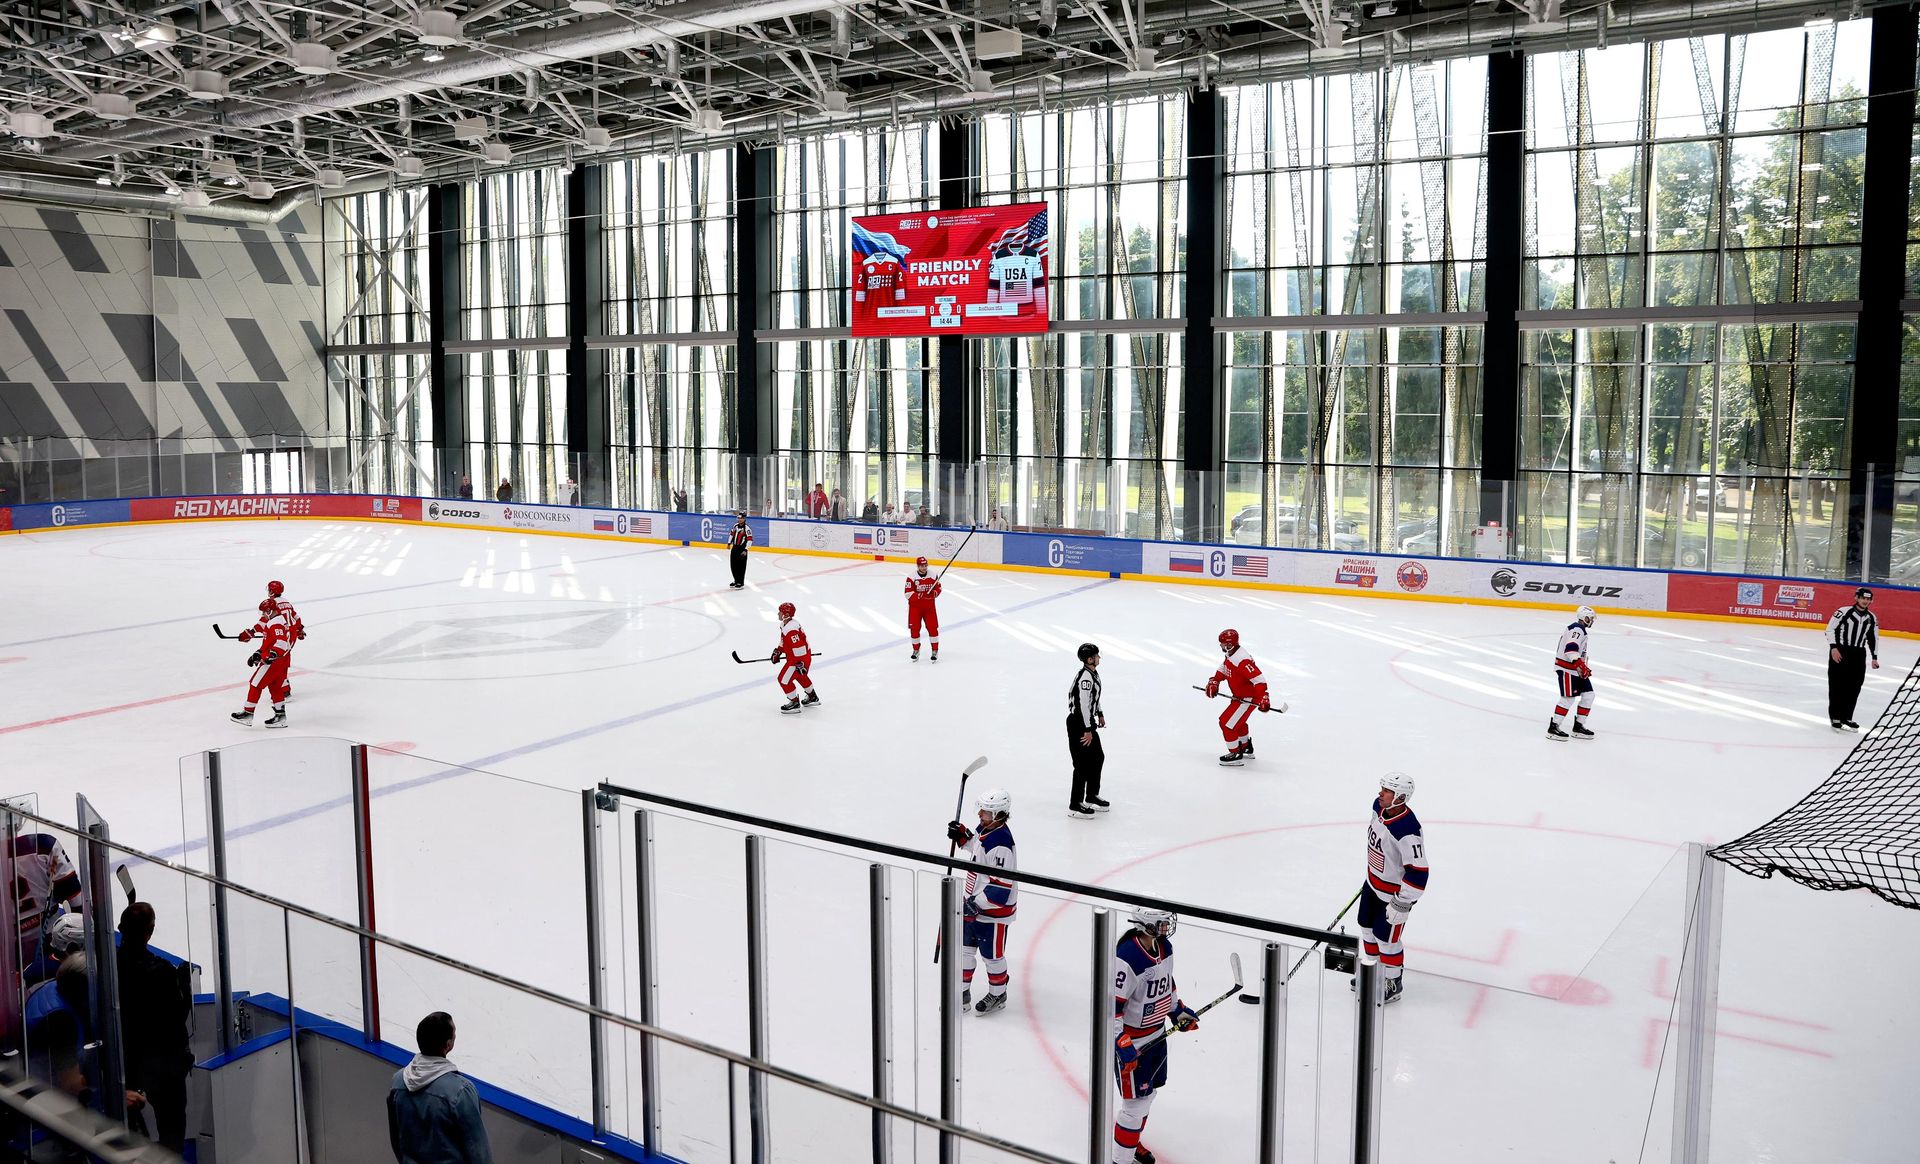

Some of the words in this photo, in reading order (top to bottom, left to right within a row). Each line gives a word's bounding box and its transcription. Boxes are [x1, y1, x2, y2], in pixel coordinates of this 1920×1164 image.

[910, 259, 982, 274] FRIENDLY
[858, 274, 862, 284] 2
[898, 272, 903, 282] 2
[1005, 268, 1027, 280] USA
[918, 274, 969, 287] MATCH
[174, 500, 212, 517] RED
[214, 498, 290, 515] MACHINE
[442, 509, 480, 518] СОЮЗ
[513, 510, 571, 522] ROSCONGRESS
[1342, 565, 1375, 574] МАШИНА
[1522, 581, 1623, 597] SOYUZ
[1729, 606, 1823, 620] T.ME/REDMACHINEJUNIOR
[1081, 681, 1091, 689] 80
[1412, 844, 1422, 858] 17
[1116, 971, 1126, 989] 2
